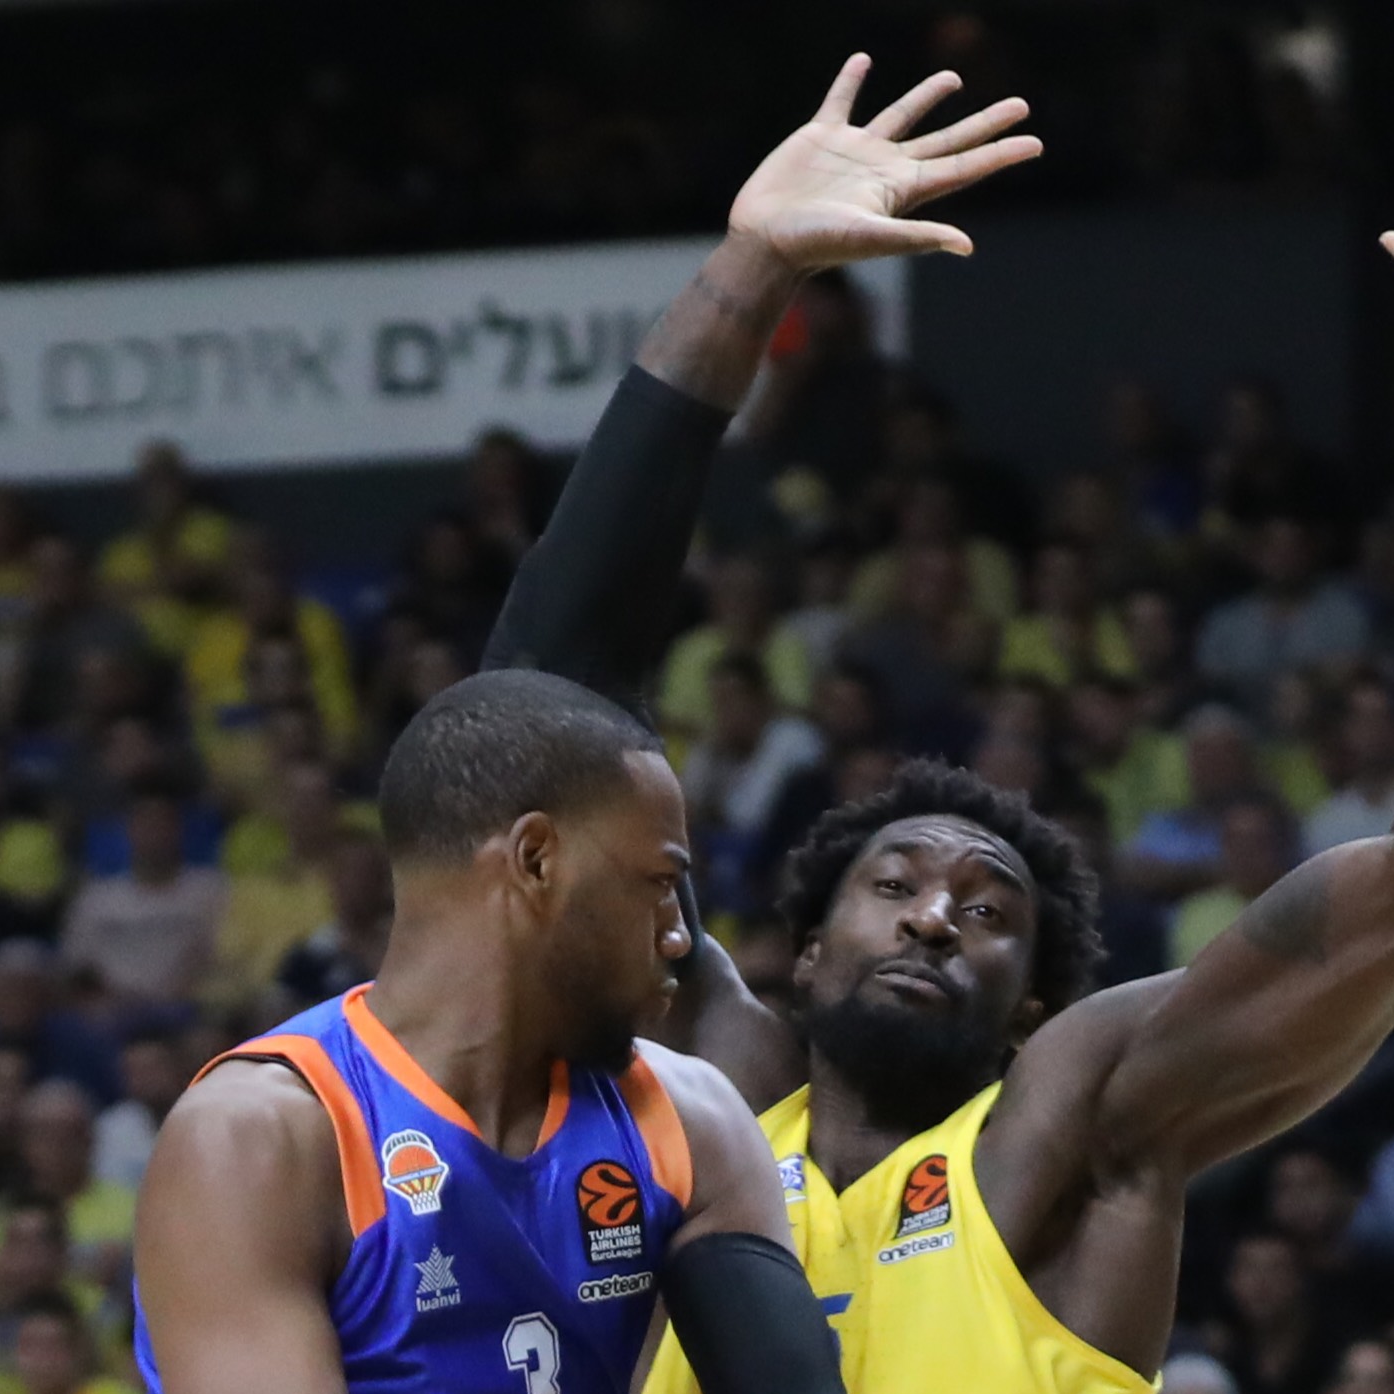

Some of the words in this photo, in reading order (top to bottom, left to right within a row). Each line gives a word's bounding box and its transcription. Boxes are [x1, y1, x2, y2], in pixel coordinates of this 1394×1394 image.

[374, 295, 641, 398] ועלים
[588, 1224, 640, 1241] TURKISH
[590, 1235, 642, 1252] AIRLINES
[591, 1247, 642, 1262] EuroLeague
